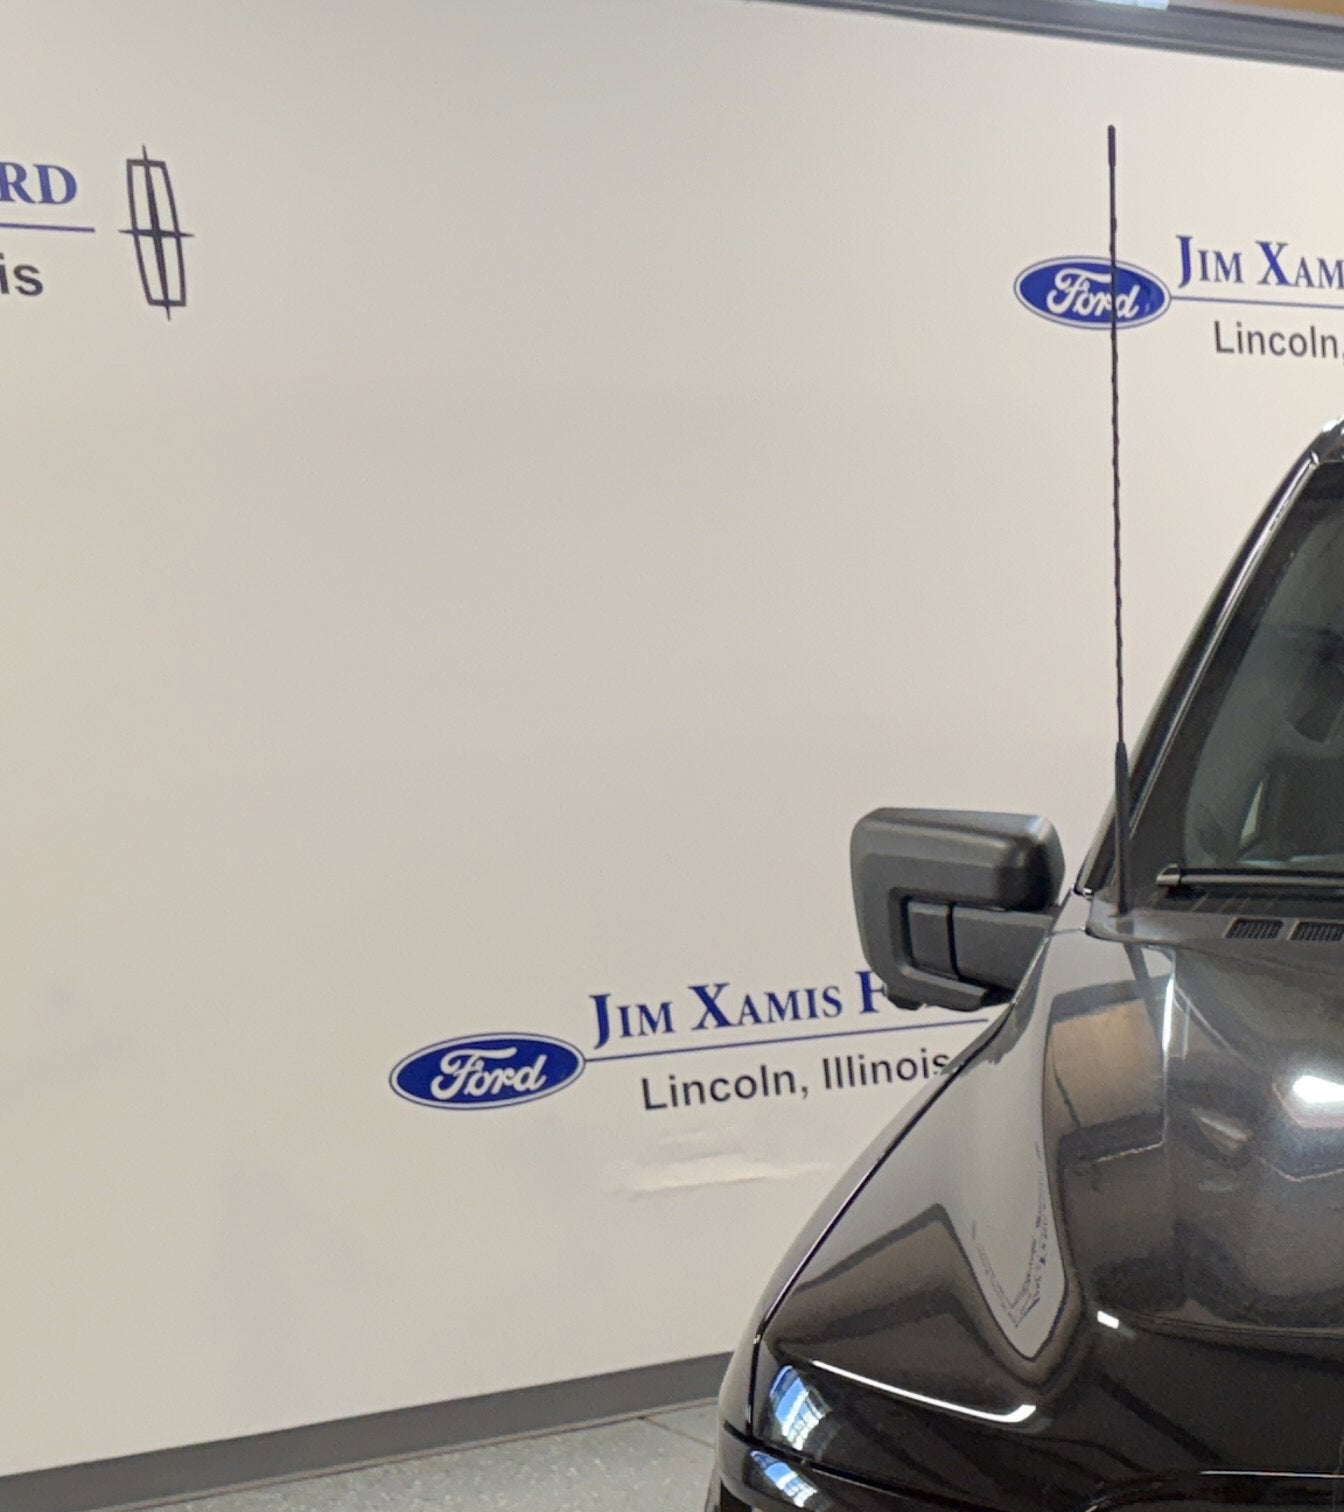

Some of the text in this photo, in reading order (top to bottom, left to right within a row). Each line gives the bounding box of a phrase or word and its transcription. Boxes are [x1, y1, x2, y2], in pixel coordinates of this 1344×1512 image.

[1176, 235, 1243, 288] JIM
[1046, 267, 1140, 319] Ford
[589, 994, 674, 1050] JIM
[688, 982, 843, 1031] XAMIS
[430, 1047, 547, 1100] Ford
[642, 1064, 809, 1110] Lincoln,
